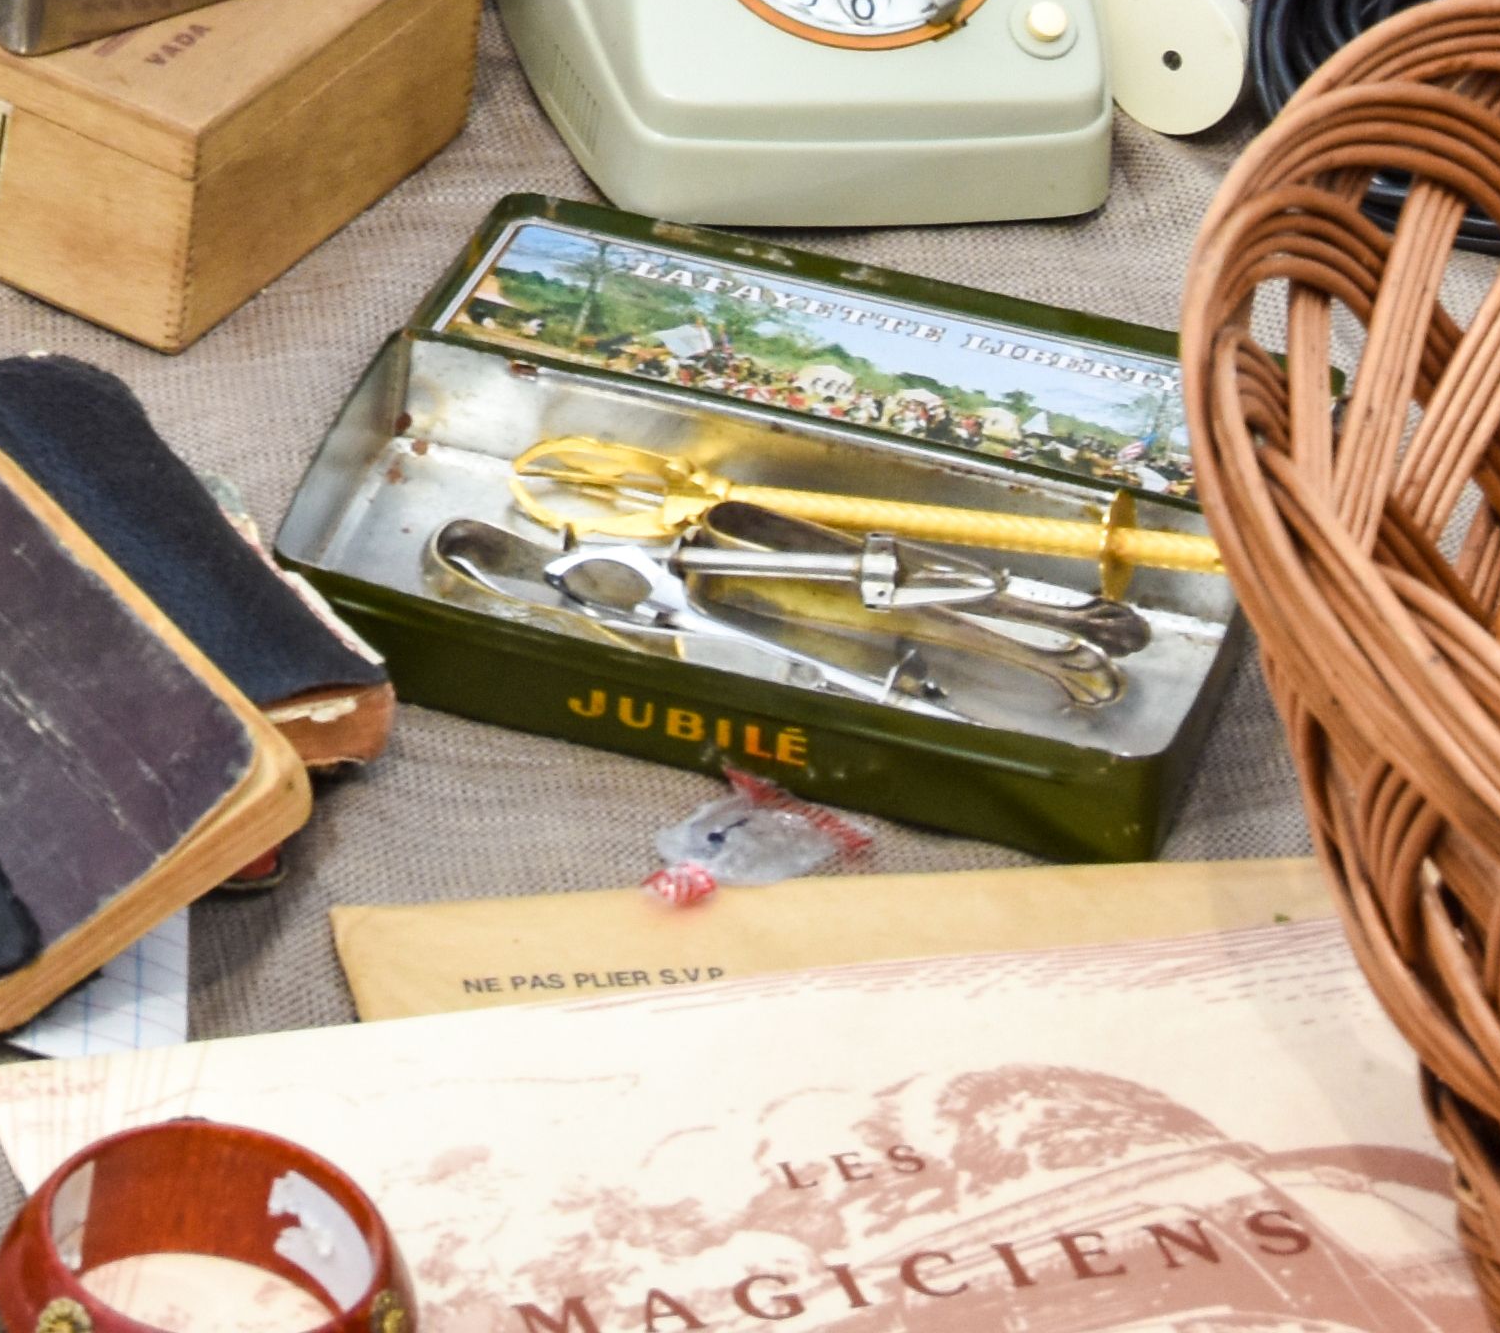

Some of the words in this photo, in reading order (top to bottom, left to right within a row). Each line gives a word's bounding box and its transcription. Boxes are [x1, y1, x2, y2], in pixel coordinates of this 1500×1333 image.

[627, 258, 945, 345] LAFAYETTE
[960, 332, 1184, 396] LIBERTY
[567, 687, 812, 767] JUBILÉ
[463, 977, 504, 994] NE
[510, 972, 566, 991] PAS
[573, 969, 651, 989] PLIER
[778, 1142, 928, 1192] LES
[514, 1207, 1318, 1333] MAGICIENS
